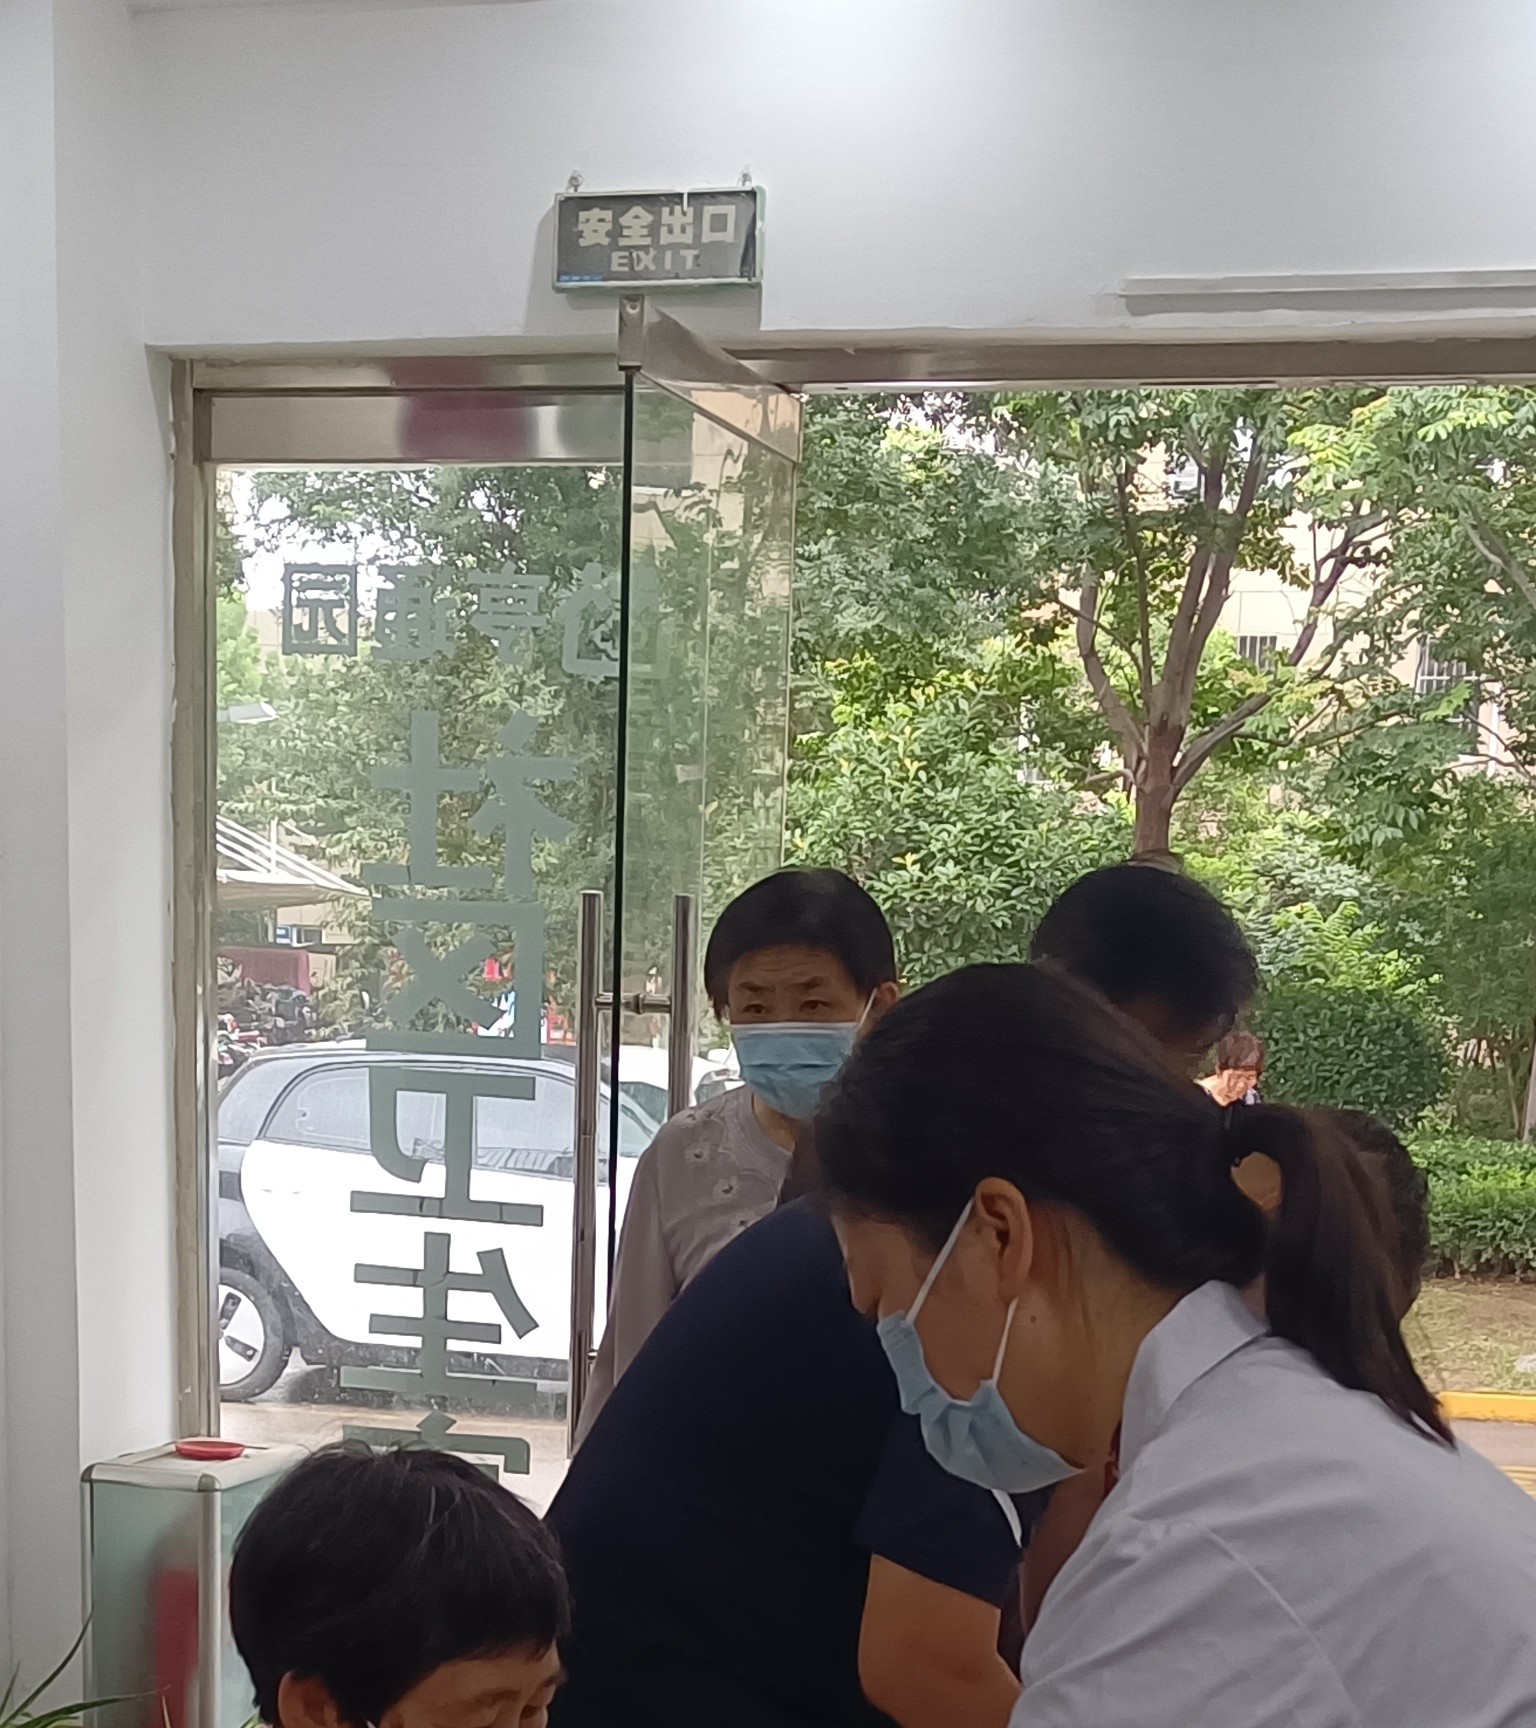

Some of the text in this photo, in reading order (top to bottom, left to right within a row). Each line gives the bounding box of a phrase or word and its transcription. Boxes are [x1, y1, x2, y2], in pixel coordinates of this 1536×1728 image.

[574, 205, 736, 247] 安全出口
[610, 248, 700, 272] EXIT
